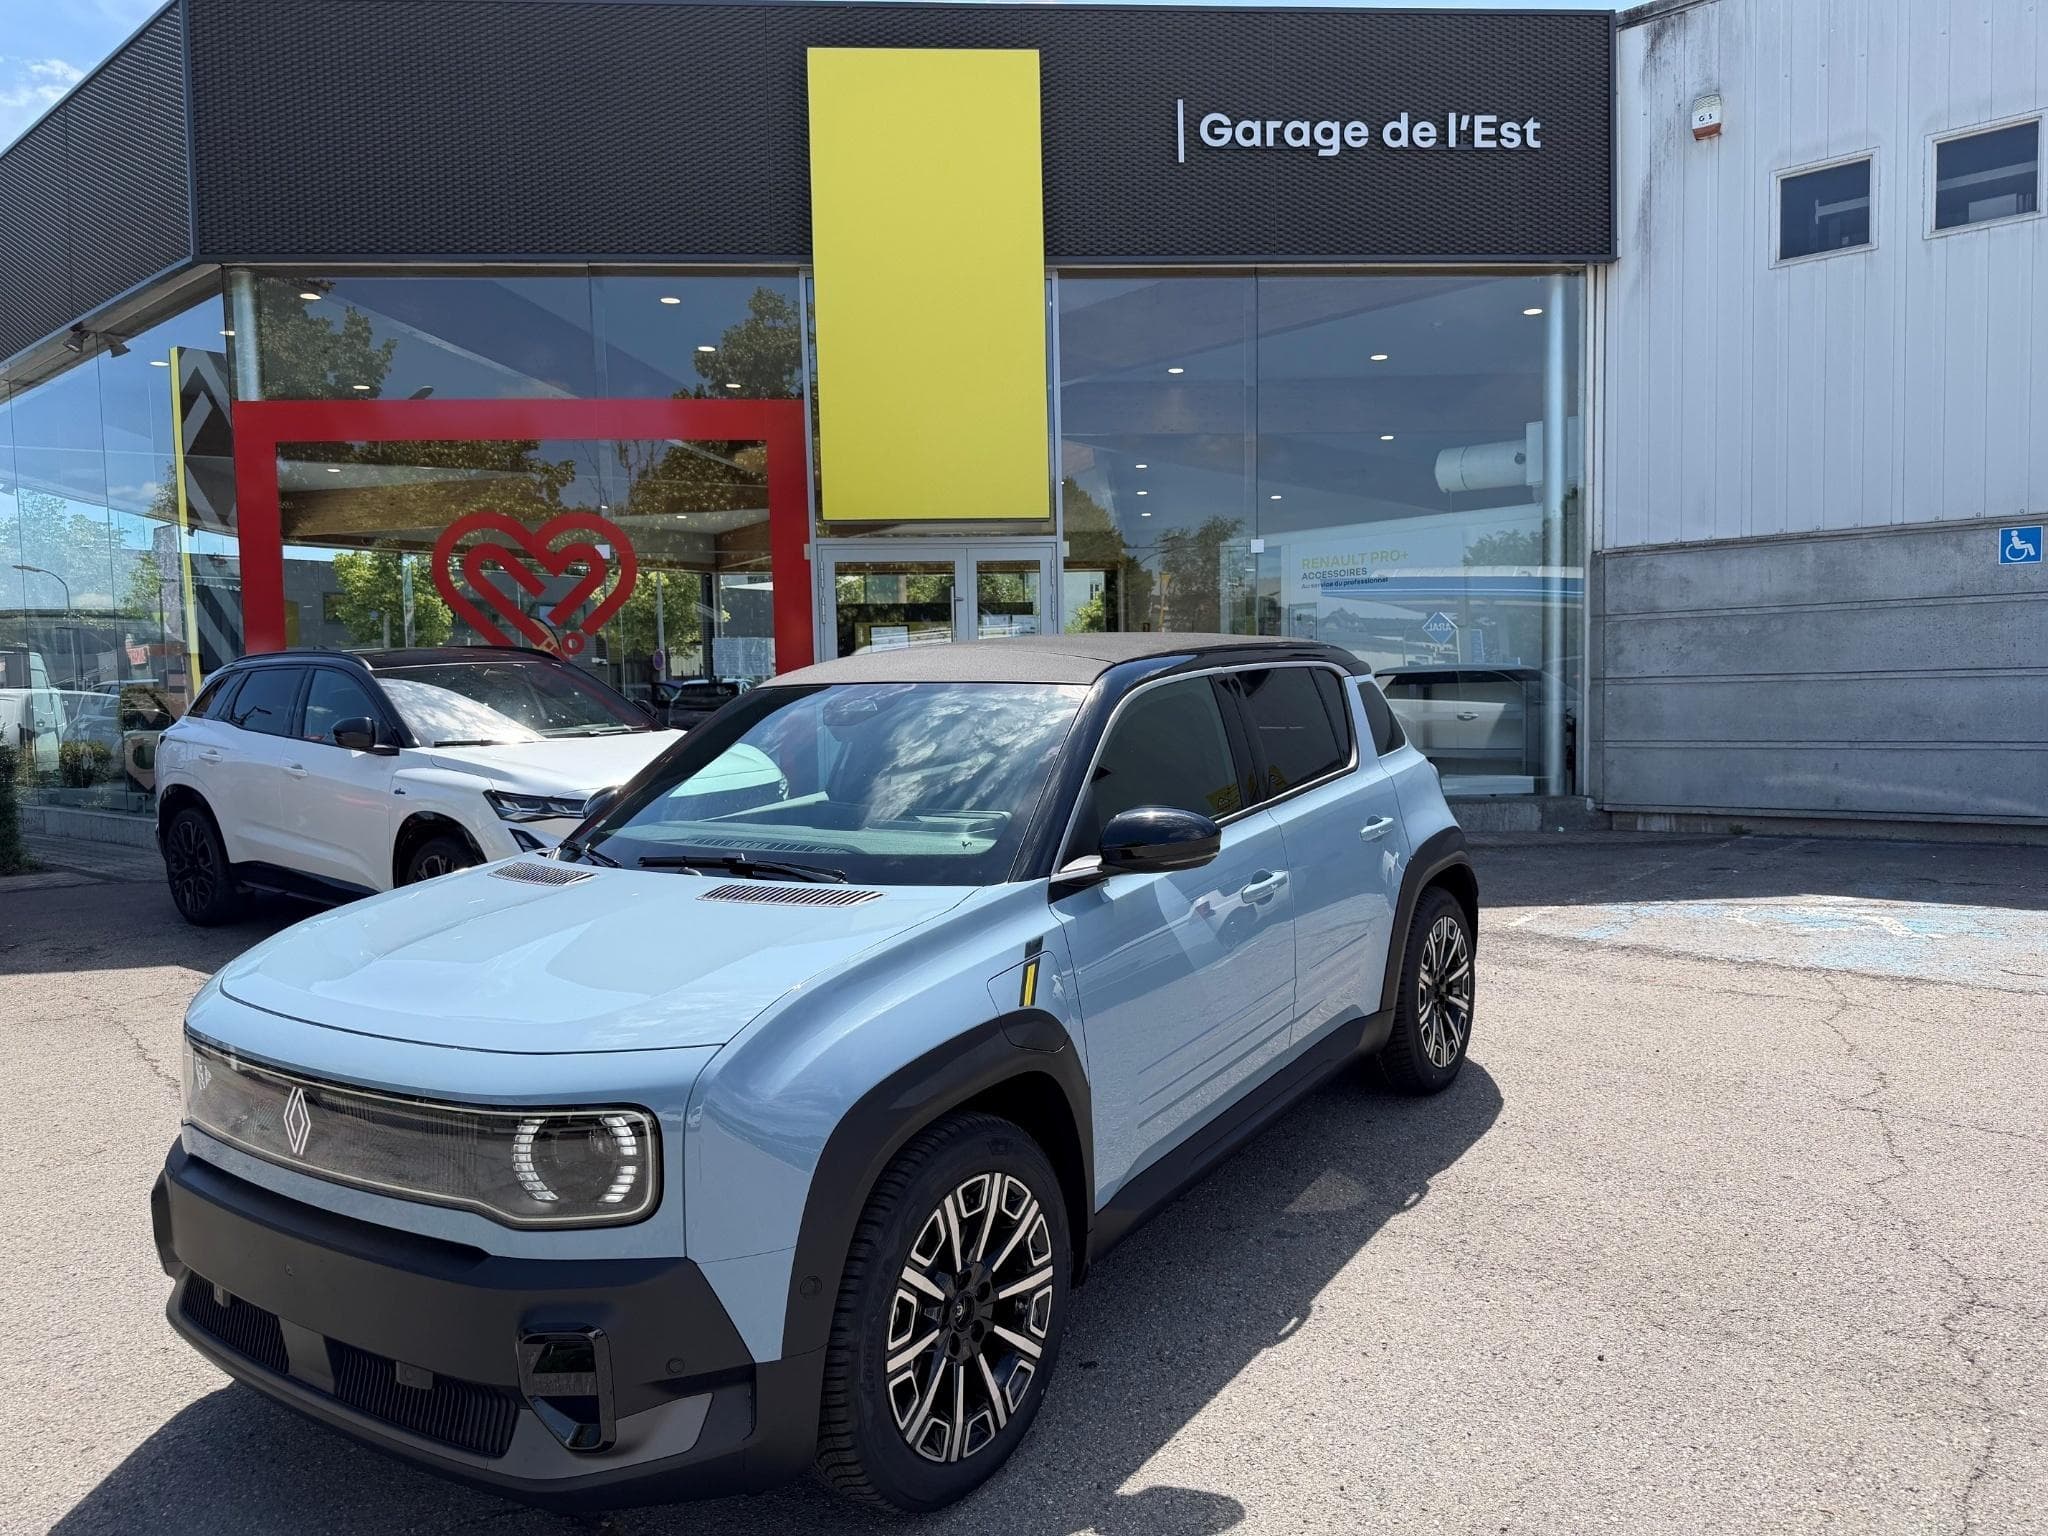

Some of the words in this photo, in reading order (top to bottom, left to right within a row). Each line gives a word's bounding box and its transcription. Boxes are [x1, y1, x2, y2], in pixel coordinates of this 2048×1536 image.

[1199, 112, 1369, 157] Garage
[1382, 111, 1437, 148] de
[1448, 112, 1541, 149] l'Est
[1302, 552, 1368, 569] RENAULT
[1370, 549, 1409, 565] PRO+
[1302, 567, 1368, 581] ACCESSOIRES
[1334, 580, 1343, 588] du
